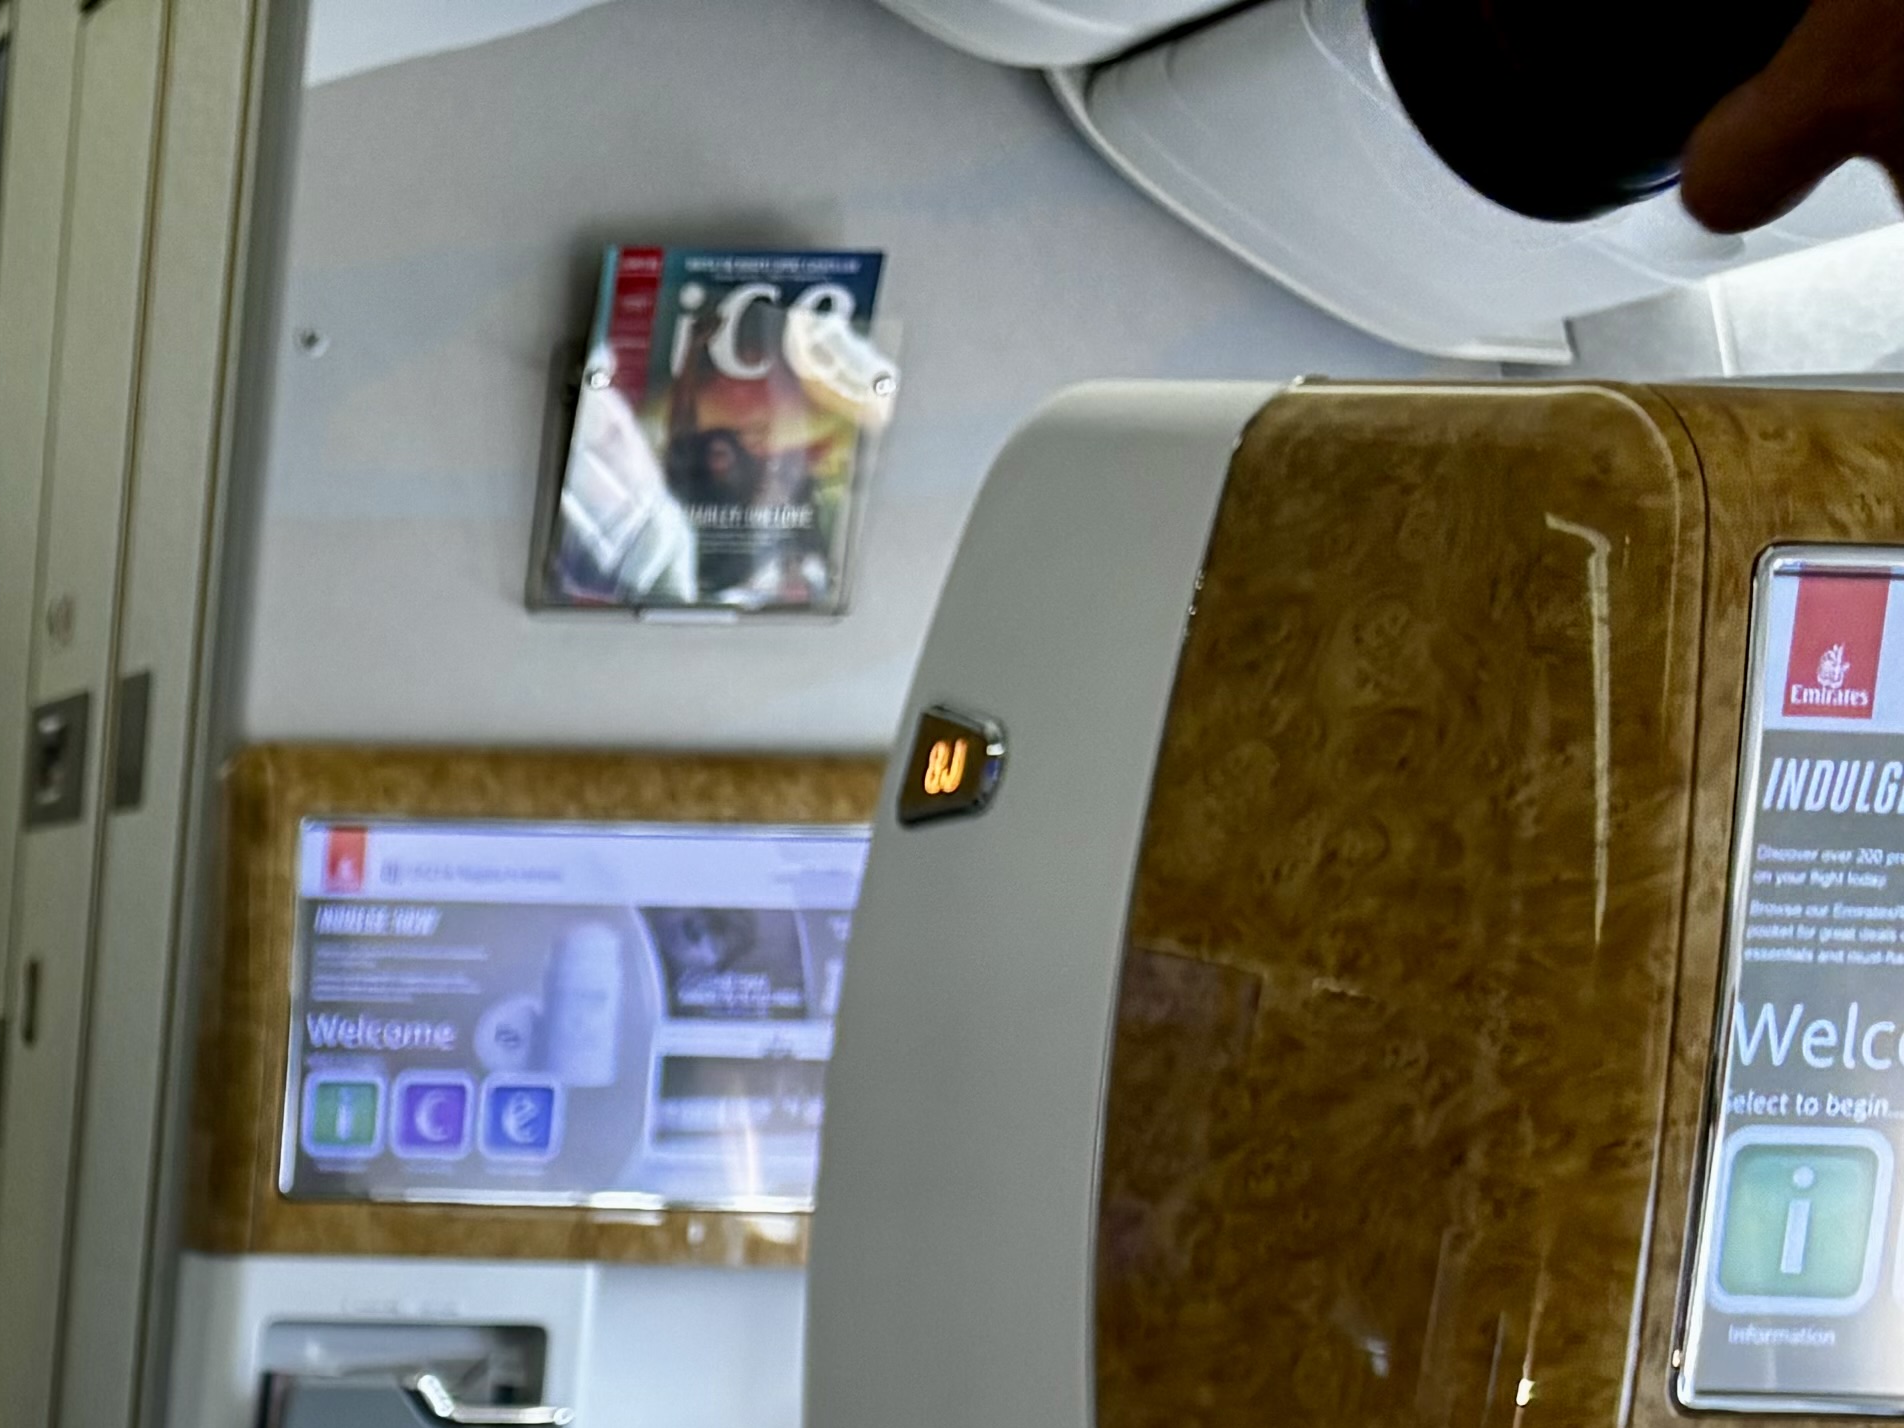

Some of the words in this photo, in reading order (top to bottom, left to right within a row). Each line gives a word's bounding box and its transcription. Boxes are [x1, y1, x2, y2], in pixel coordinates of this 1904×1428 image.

[1791, 684, 1868, 706] Emirates
[924, 738, 968, 794] 8J
[307, 1013, 456, 1051] Welcome
[1734, 1001, 1904, 1070] Welc
[1796, 1093, 1819, 1117] to
[1729, 1324, 1836, 1347] Information
